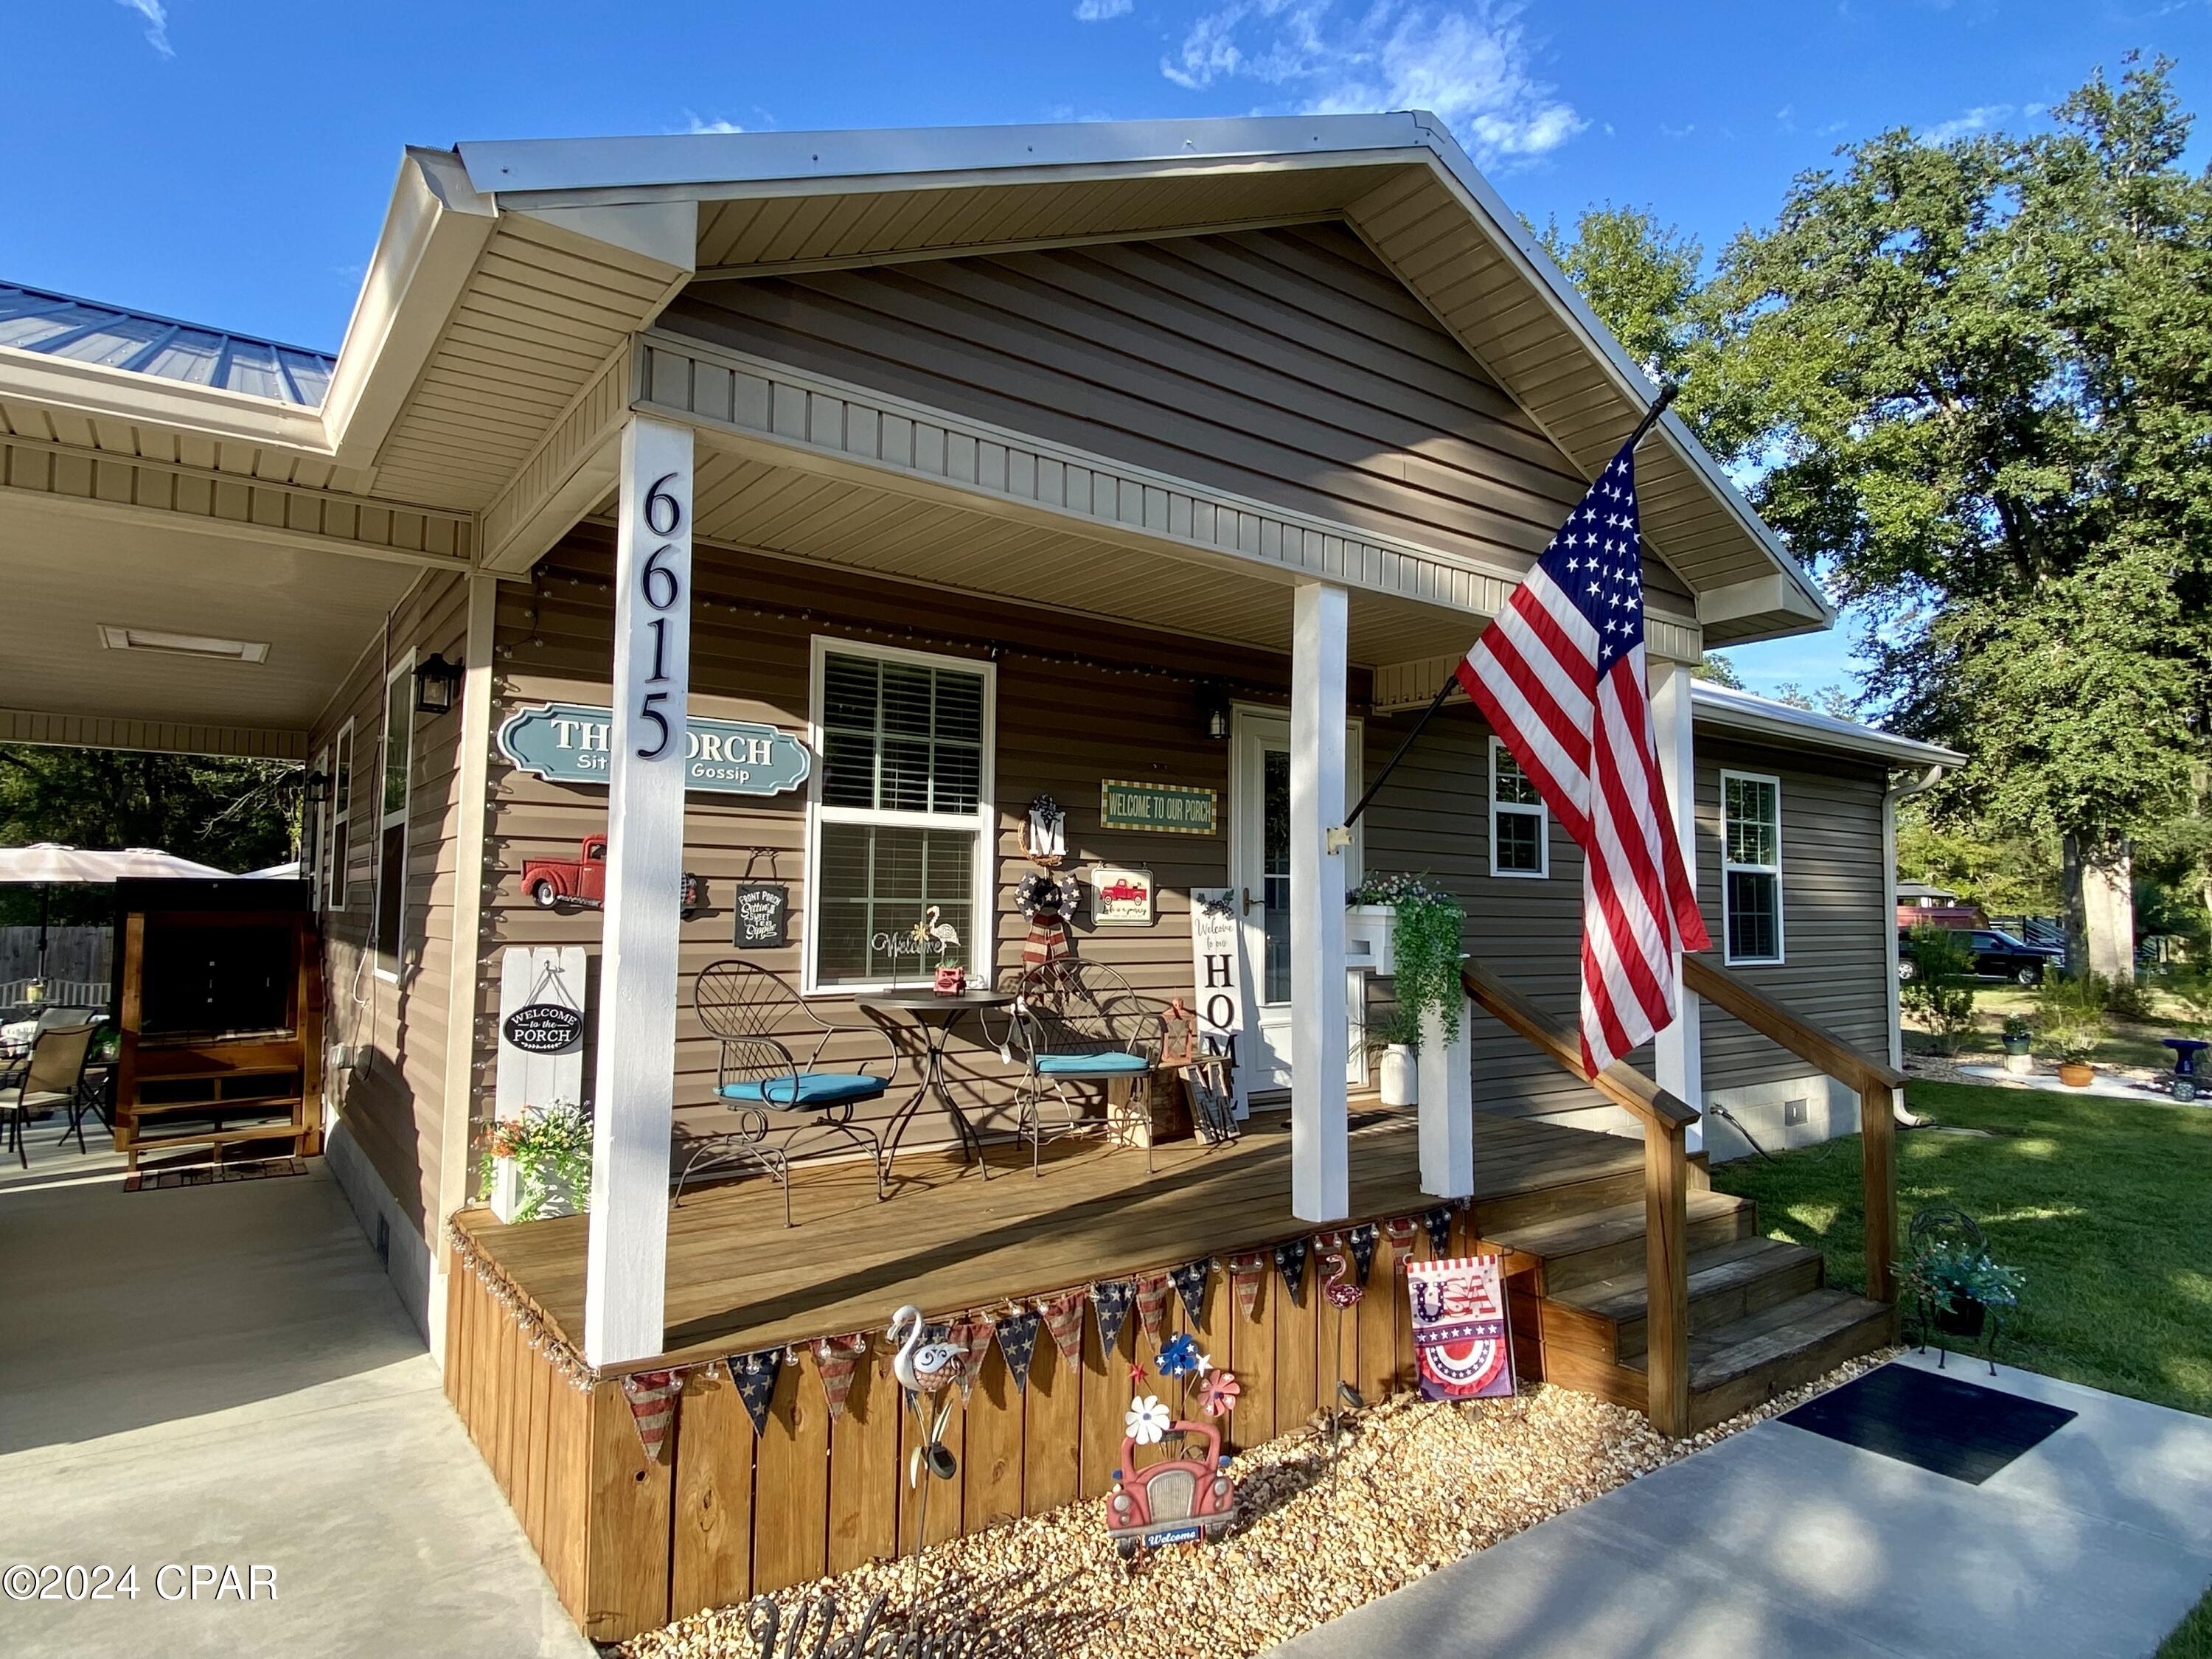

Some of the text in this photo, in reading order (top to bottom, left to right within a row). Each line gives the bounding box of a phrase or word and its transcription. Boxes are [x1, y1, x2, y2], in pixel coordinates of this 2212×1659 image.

[636, 472, 681, 759] 6615
[551, 719, 773, 766] TH ORCH
[577, 754, 751, 785] Sit Gossip
[1109, 792, 1211, 823] WELCOME TO OUR PORCH
[738, 891, 782, 906] FRONT PORCH
[749, 913, 771, 921] SWEET
[1194, 917, 1234, 936] Welcome
[511, 1008, 577, 1026] WELCOME
[529, 1019, 557, 1029] to the
[512, 1029, 571, 1042] PORCH
[1411, 1275, 1497, 1323] USA
[1148, 1531, 1196, 1545] Welcome
